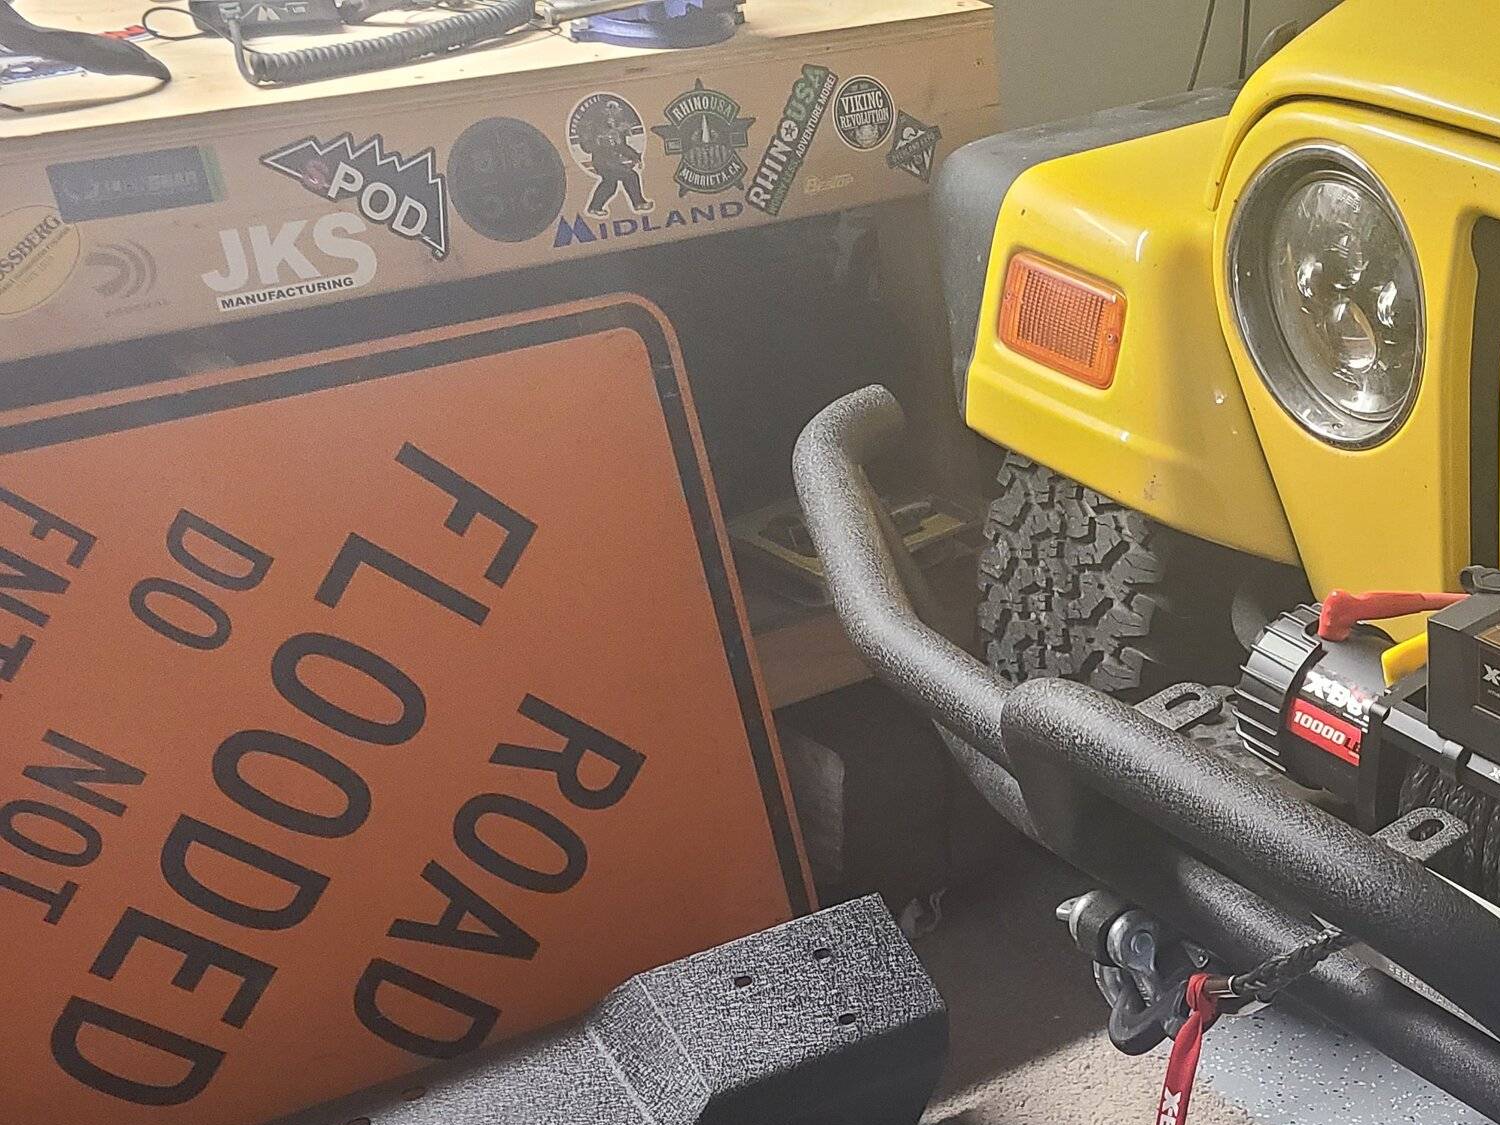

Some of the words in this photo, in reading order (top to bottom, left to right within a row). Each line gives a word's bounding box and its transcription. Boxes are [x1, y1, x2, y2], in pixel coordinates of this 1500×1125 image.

[796, 104, 822, 158] ADVENTURE
[839, 107, 890, 130] REVOLUTION
[840, 91, 884, 113] VIKING
[328, 161, 427, 236] POD
[553, 202, 744, 247] MIDLAND
[0, 214, 61, 281] SSBERG
[201, 212, 378, 292] JKS
[221, 277, 354, 309] MANUFACTURING
[129, 508, 274, 650] DO
[50, 441, 538, 1106] FLOODED
[0, 729, 147, 925] NOT
[353, 693, 646, 1060] ROAD
